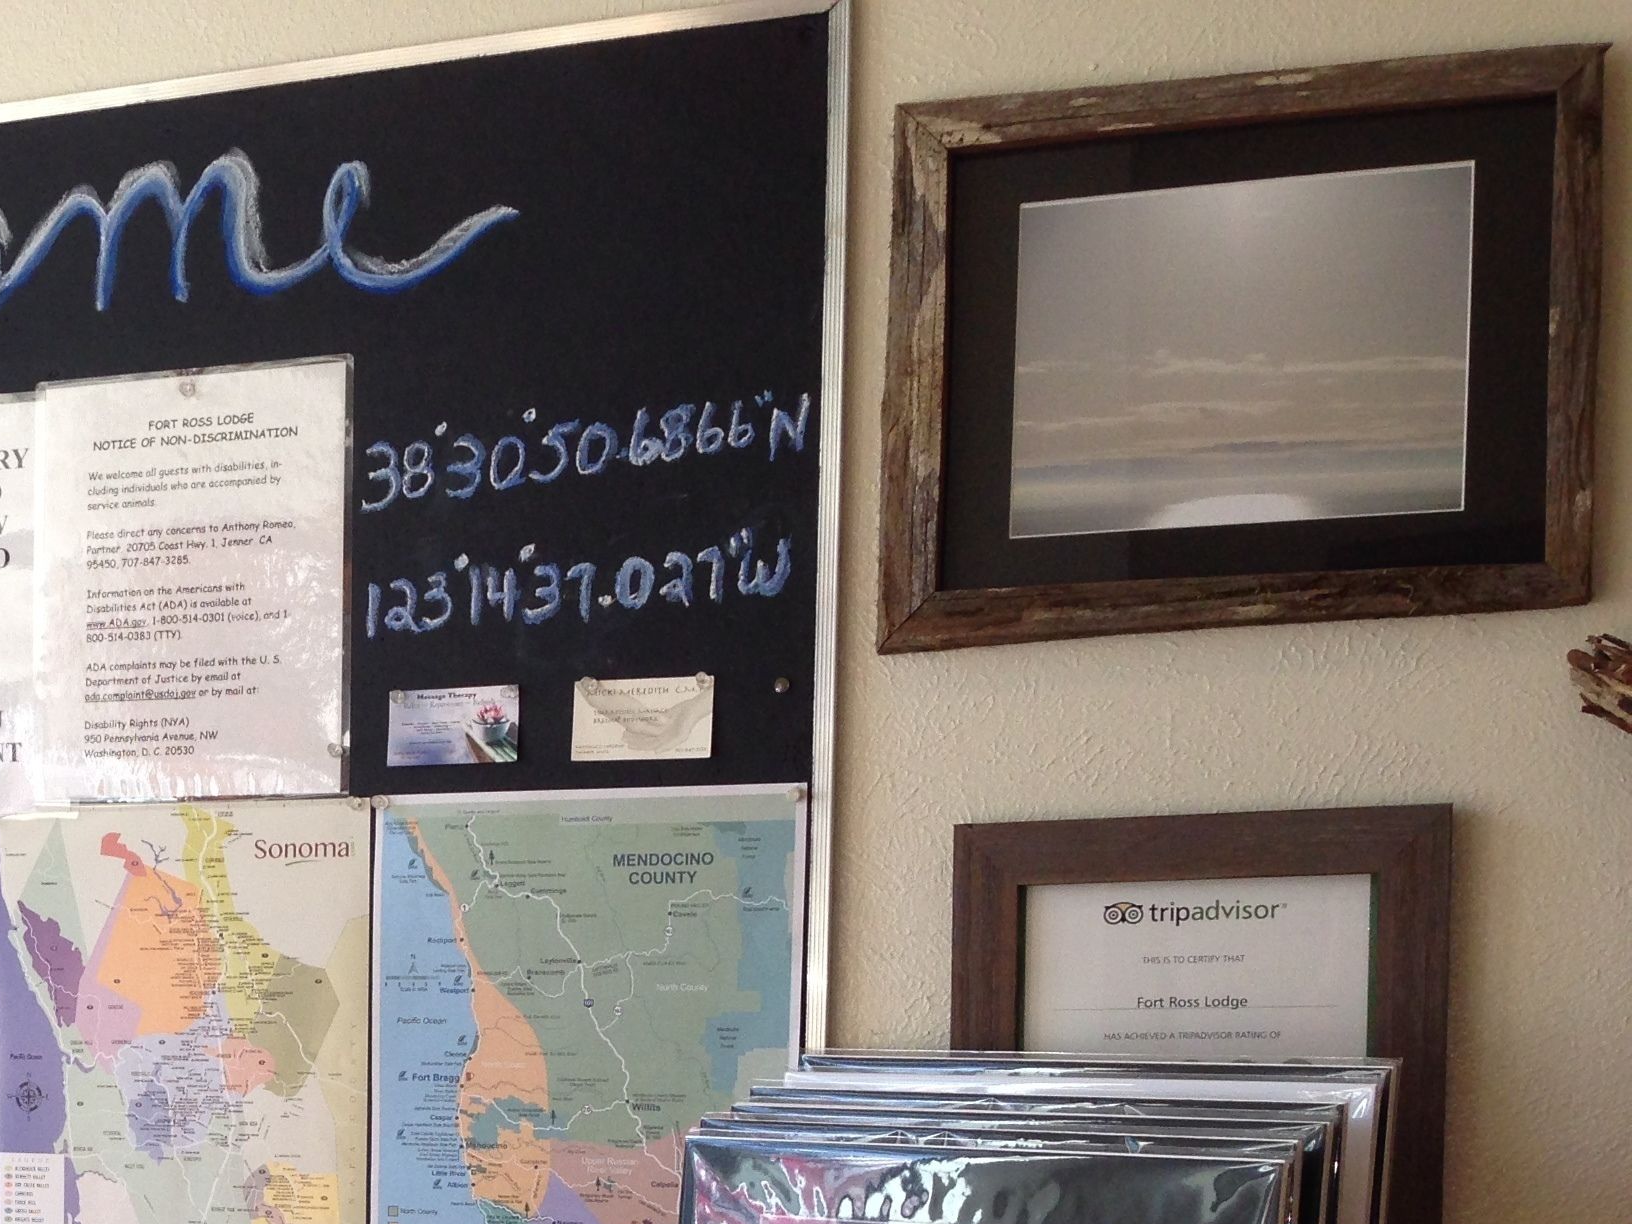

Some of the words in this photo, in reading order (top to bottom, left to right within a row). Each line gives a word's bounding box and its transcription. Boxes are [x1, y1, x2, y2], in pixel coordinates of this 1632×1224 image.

[148, 418, 179, 431] FORT
[182, 416, 214, 428] ROSS
[217, 412, 256, 426] LODGE
[93, 437, 137, 452] NOTICE
[140, 436, 157, 448] OF
[160, 426, 299, 447] NON-DISCRIMINATION
[88, 472, 104, 481] We
[106, 470, 144, 480] welcome
[146, 467, 157, 477] all
[158, 467, 190, 479] guests
[191, 465, 213, 474] with
[270, 461, 284, 469] in-
[87, 486, 120, 497] cluding
[121, 482, 168, 493] individuals
[170, 481, 190, 490] who
[191, 480, 207, 489] are
[208, 475, 268, 489] accompanied
[270, 474, 283, 486] by
[87, 502, 119, 511] service
[86, 530, 115, 541] Please
[117, 528, 145, 538] direct
[147, 528, 163, 539] any
[165, 525, 206, 536] concerns
[209, 525, 220, 534] to
[222, 521, 261, 534] Anthony
[126, 541, 157, 552] 20705
[159, 541, 184, 551] Coast
[259, 535, 273, 545] CA
[86, 588, 142, 600] Information
[144, 588, 155, 598] on
[157, 587, 173, 596] the
[175, 583, 223, 595] Americans
[225, 582, 245, 592] with
[86, 602, 136, 615] Disabilities
[139, 601, 156, 611] Act
[158, 599, 188, 612] (ADA)
[200, 598, 240, 608] available
[241, 598, 253, 606] at
[152, 612, 225, 626] 1-800-514-0301
[262, 610, 281, 620] and
[86, 661, 107, 673] ADA
[109, 659, 157, 672] complaints
[159, 659, 177, 671] may
[179, 658, 192, 668] be
[193, 656, 216, 667] filed
[218, 655, 239, 665] with
[241, 655, 257, 664] the
[85, 674, 139, 687] Department
[141, 673, 153, 684] of
[154, 672, 190, 684] Justice
[191, 674, 202, 685] by
[204, 671, 229, 682] email
[230, 672, 242, 681] at
[198, 690, 210, 698] or
[211, 687, 223, 698] by
[225, 685, 245, 696] mail
[448, 692, 478, 700] Therapy
[84, 718, 126, 731] Disability
[128, 717, 159, 729] Rights
[161, 716, 190, 729] (NYA)
[84, 733, 102, 744] 950
[103, 730, 160, 743] Pennsylvania
[199, 730, 219, 740] NW
[141, 747, 152, 757] D.
[165, 744, 196, 755] 20530
[253, 839, 351, 860] Sonoma
[612, 851, 715, 868] MENDOCINO
[628, 870, 698, 885] COUNTY
[1149, 899, 1281, 928] tripadvisor
[1173, 955, 1186, 964] TO
[1222, 953, 1246, 963] THAT
[1137, 995, 1166, 1009] Fort
[1168, 995, 1201, 1009] Ross
[1204, 994, 1249, 1011] Lodge
[396, 1015, 421, 1025] Pacific
[422, 1015, 448, 1025] Ocean
[1104, 1032, 1123, 1041] HAS
[1234, 1030, 1268, 1040] RATING
[1269, 1030, 1282, 1040] OF
[412, 1073, 431, 1083] Fort
[433, 1072, 461, 1085] Bragg
[631, 1102, 662, 1113] Willits
